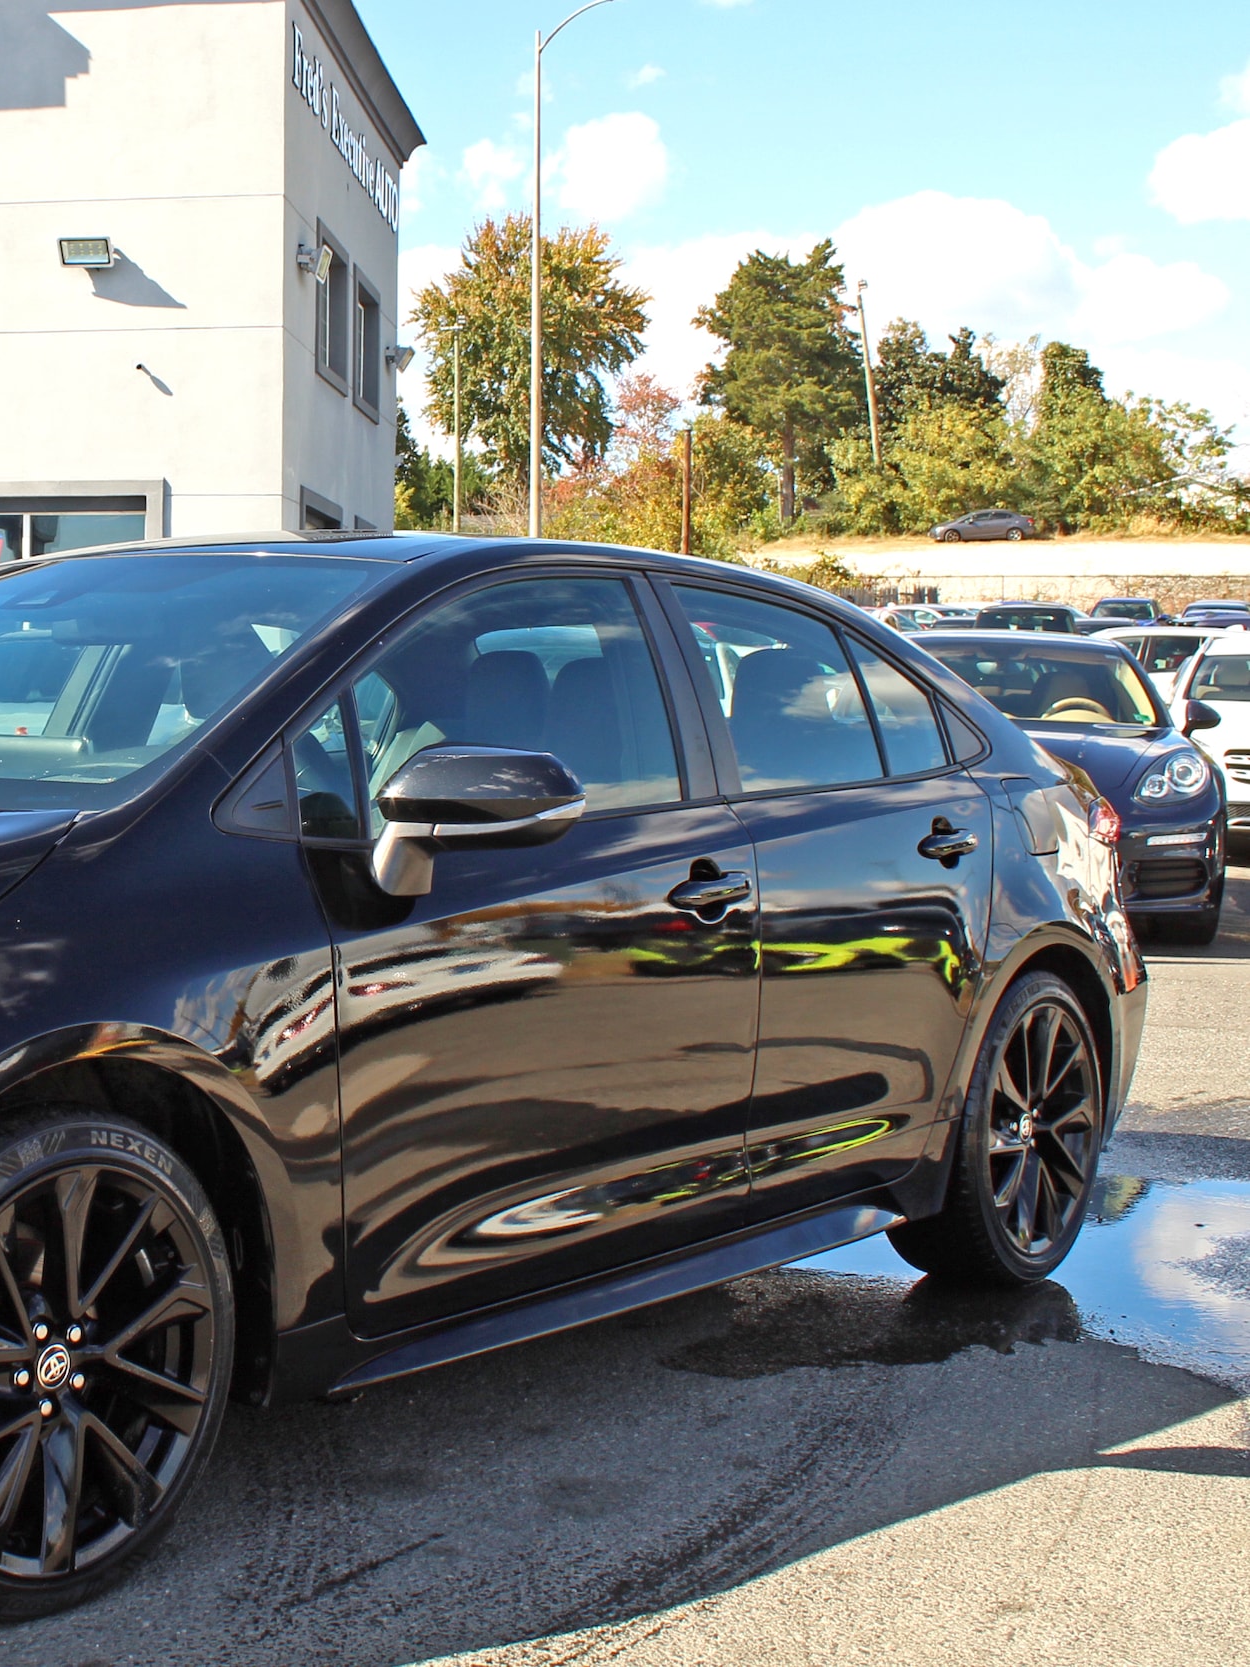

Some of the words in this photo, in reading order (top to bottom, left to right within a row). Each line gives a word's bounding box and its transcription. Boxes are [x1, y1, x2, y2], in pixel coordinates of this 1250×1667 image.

[292, 20, 328, 129] Fred's
[330, 82, 374, 199] Executive
[373, 157, 399, 233] AUTO
[90, 1130, 173, 1175] NEXEN
